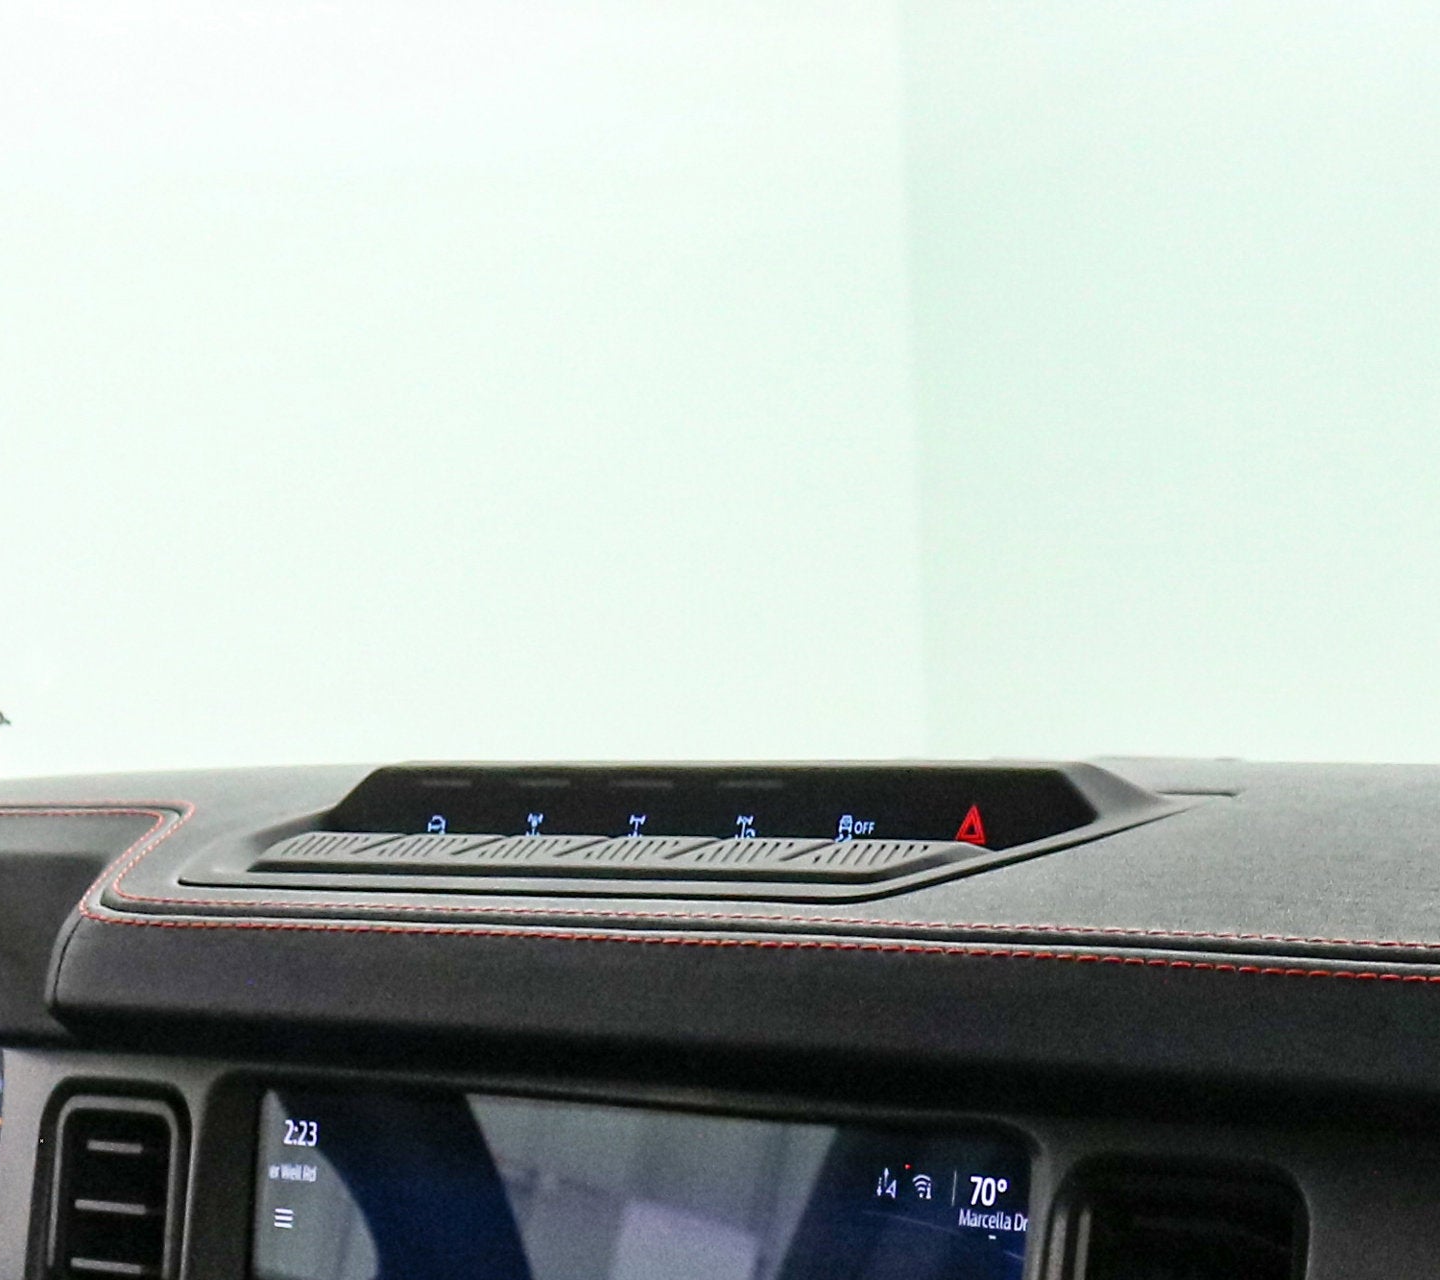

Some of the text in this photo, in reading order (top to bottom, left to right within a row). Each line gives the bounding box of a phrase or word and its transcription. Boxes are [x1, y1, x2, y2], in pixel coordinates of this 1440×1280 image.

[854, 820, 875, 835] OFF
[283, 1119, 318, 1147] 2:23
[958, 1208, 1011, 1231] Marcella
